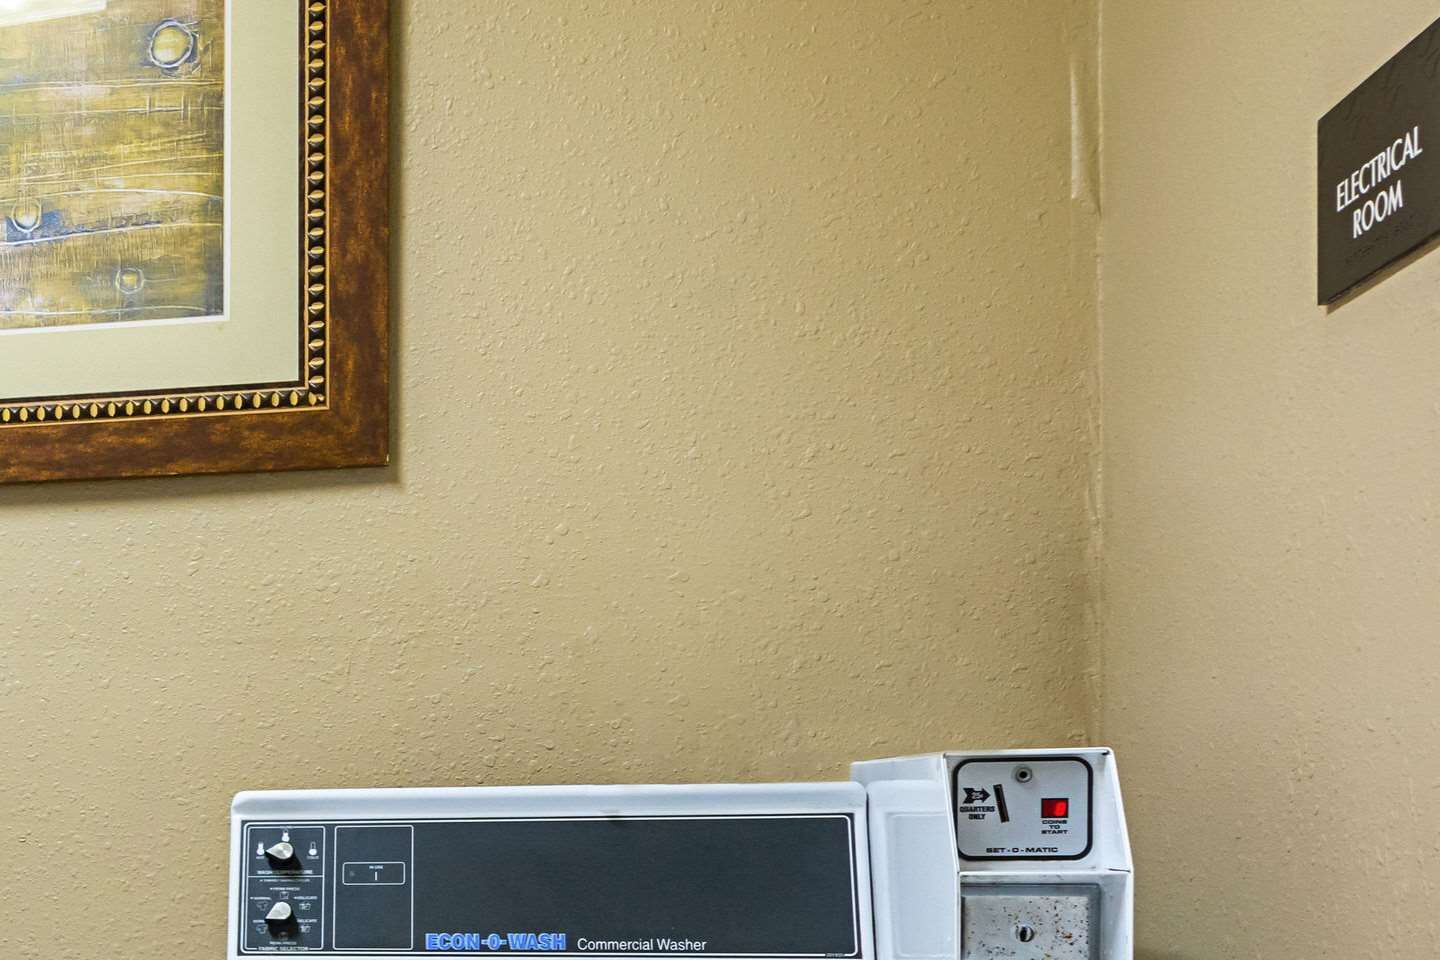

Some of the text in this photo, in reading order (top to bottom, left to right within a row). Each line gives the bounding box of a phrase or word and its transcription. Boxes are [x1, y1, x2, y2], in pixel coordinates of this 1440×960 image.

[1336, 126, 1423, 212] ELECTRICAL
[1353, 180, 1403, 238] ROOM
[425, 932, 567, 950] ECON-O-WASH
[576, 937, 708, 951] Commercial Washer
